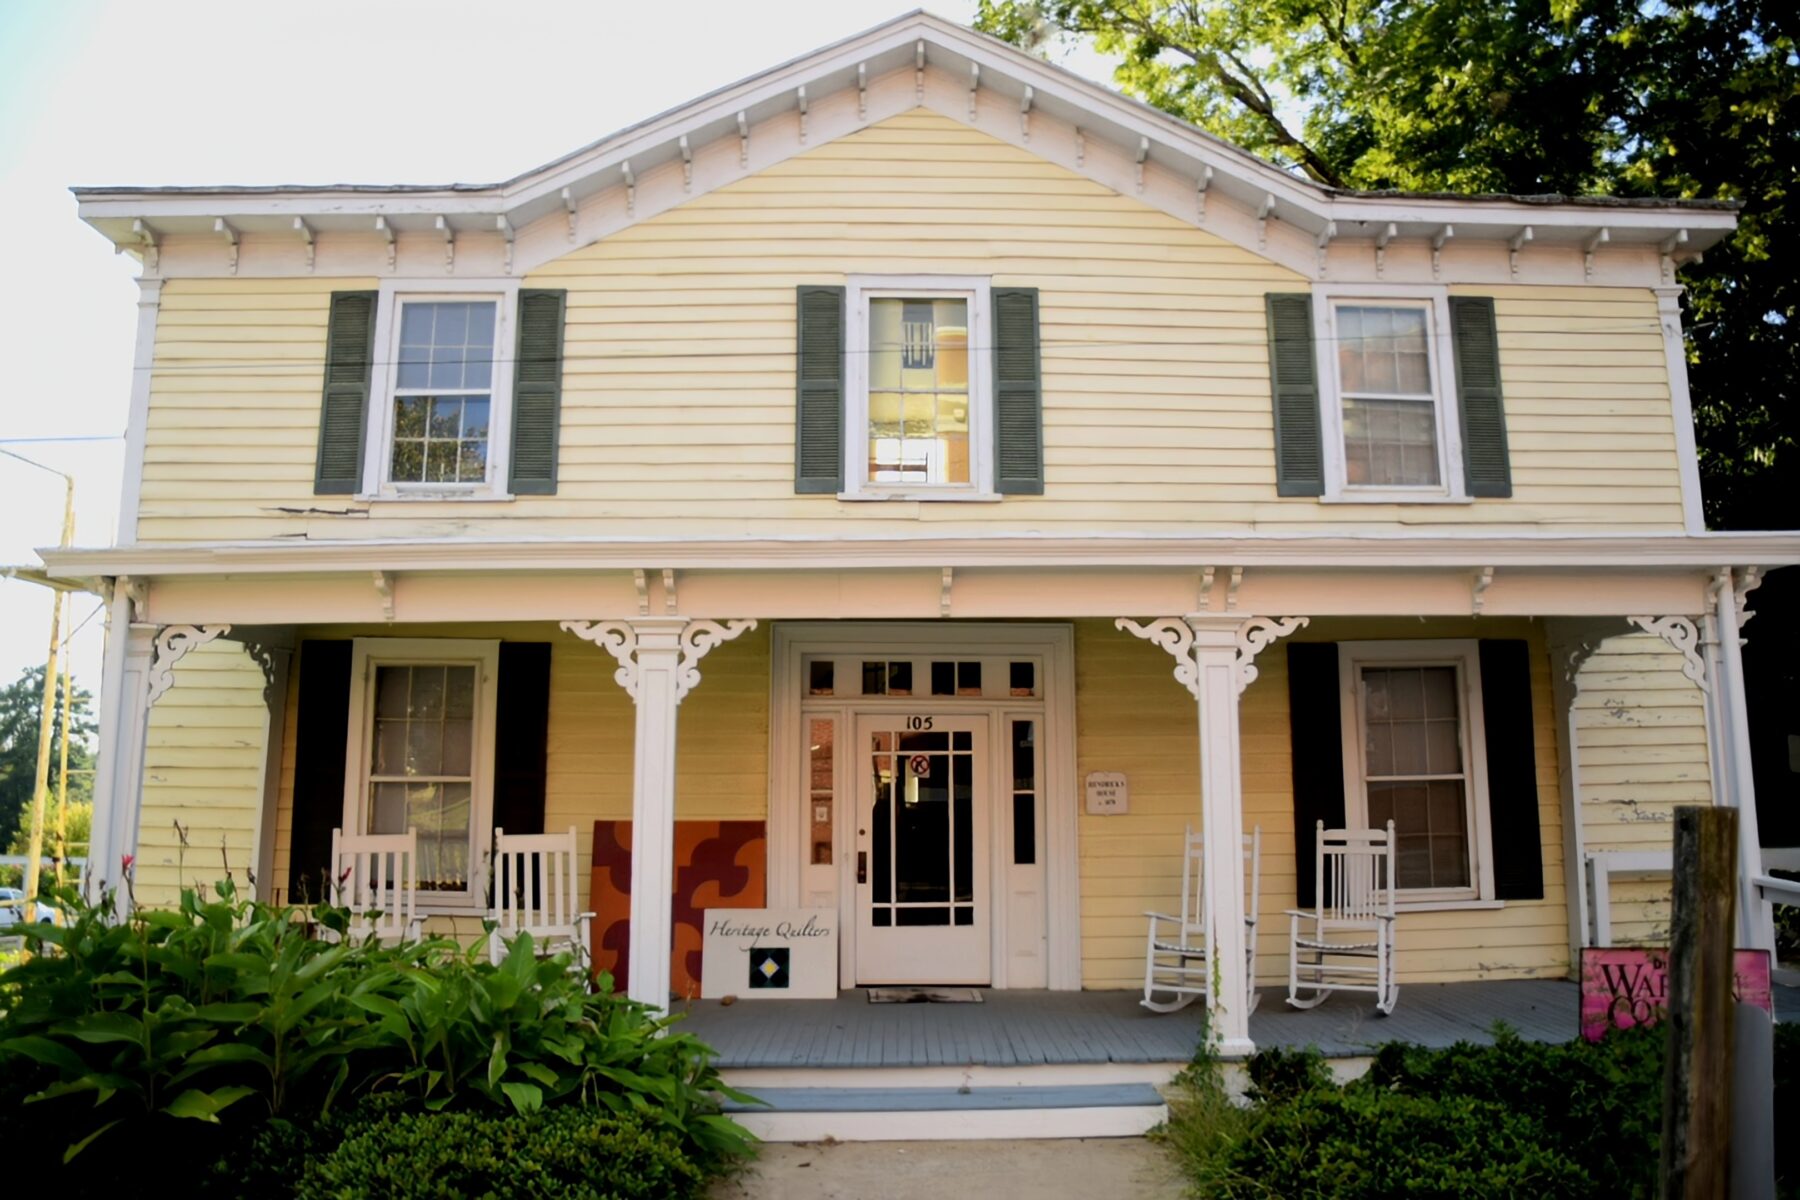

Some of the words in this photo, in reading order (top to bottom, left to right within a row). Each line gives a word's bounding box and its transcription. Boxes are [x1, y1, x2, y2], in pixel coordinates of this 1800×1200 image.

[907, 716, 933, 730] 105
[710, 919, 771, 952] Heritage
[776, 914, 830, 940] Quilters
